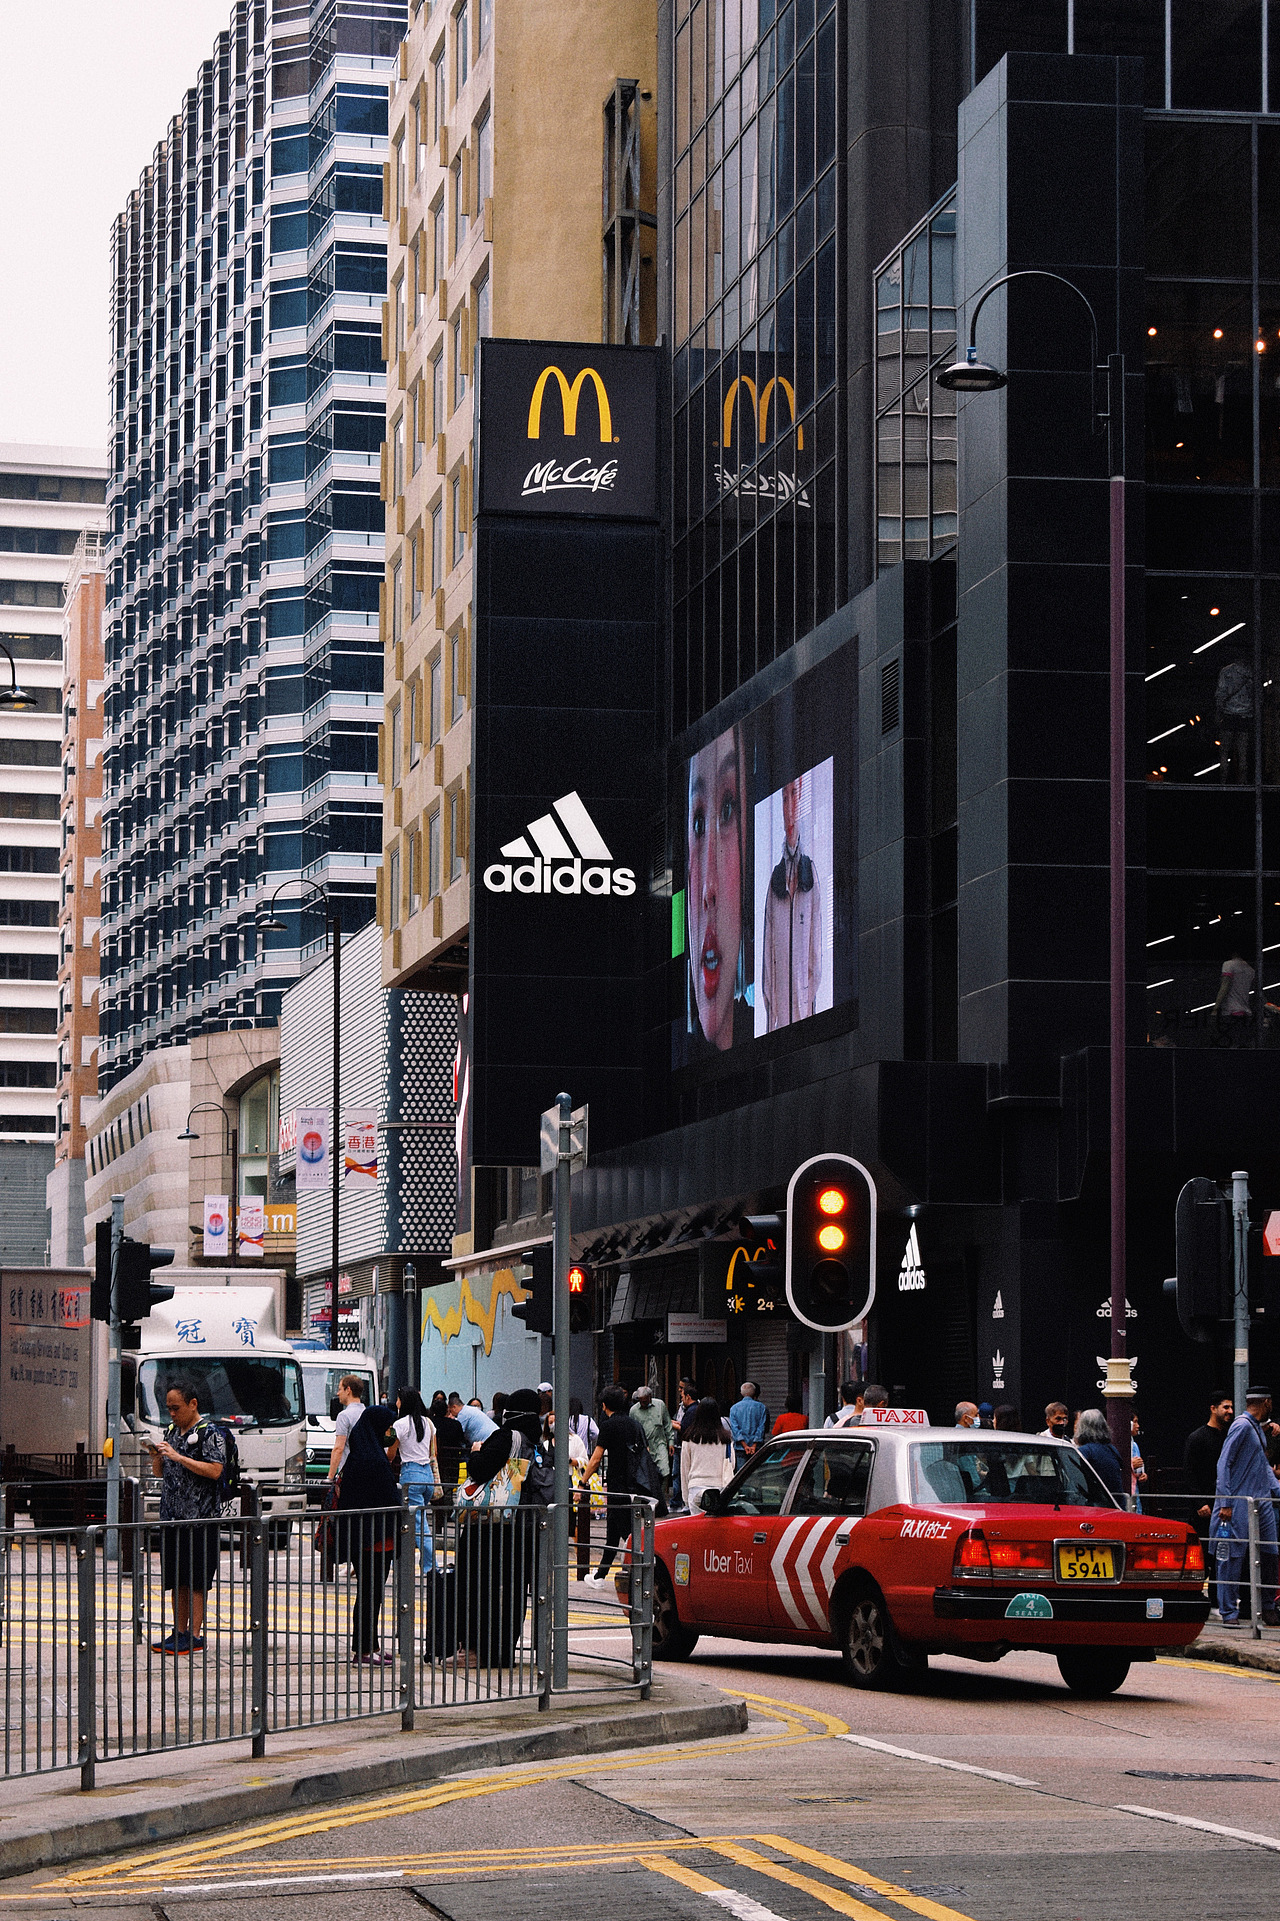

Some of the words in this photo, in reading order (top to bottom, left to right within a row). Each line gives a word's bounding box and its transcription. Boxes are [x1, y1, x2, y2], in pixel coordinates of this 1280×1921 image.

[521, 457, 618, 496] McCafé
[483, 857, 636, 896] adidas
[347, 1135, 376, 1149] 香港
[898, 1266, 926, 1291] adidas
[757, 1298, 775, 1311] 24
[1096, 1307, 1138, 1318] adas
[872, 1409, 924, 1424] TAXI
[703, 1549, 732, 1573] Uber
[733, 1550, 754, 1574] Taxi
[1075, 1547, 1098, 1562] PT
[1067, 1562, 1108, 1578] 5941
[1025, 1600, 1035, 1611] 4
